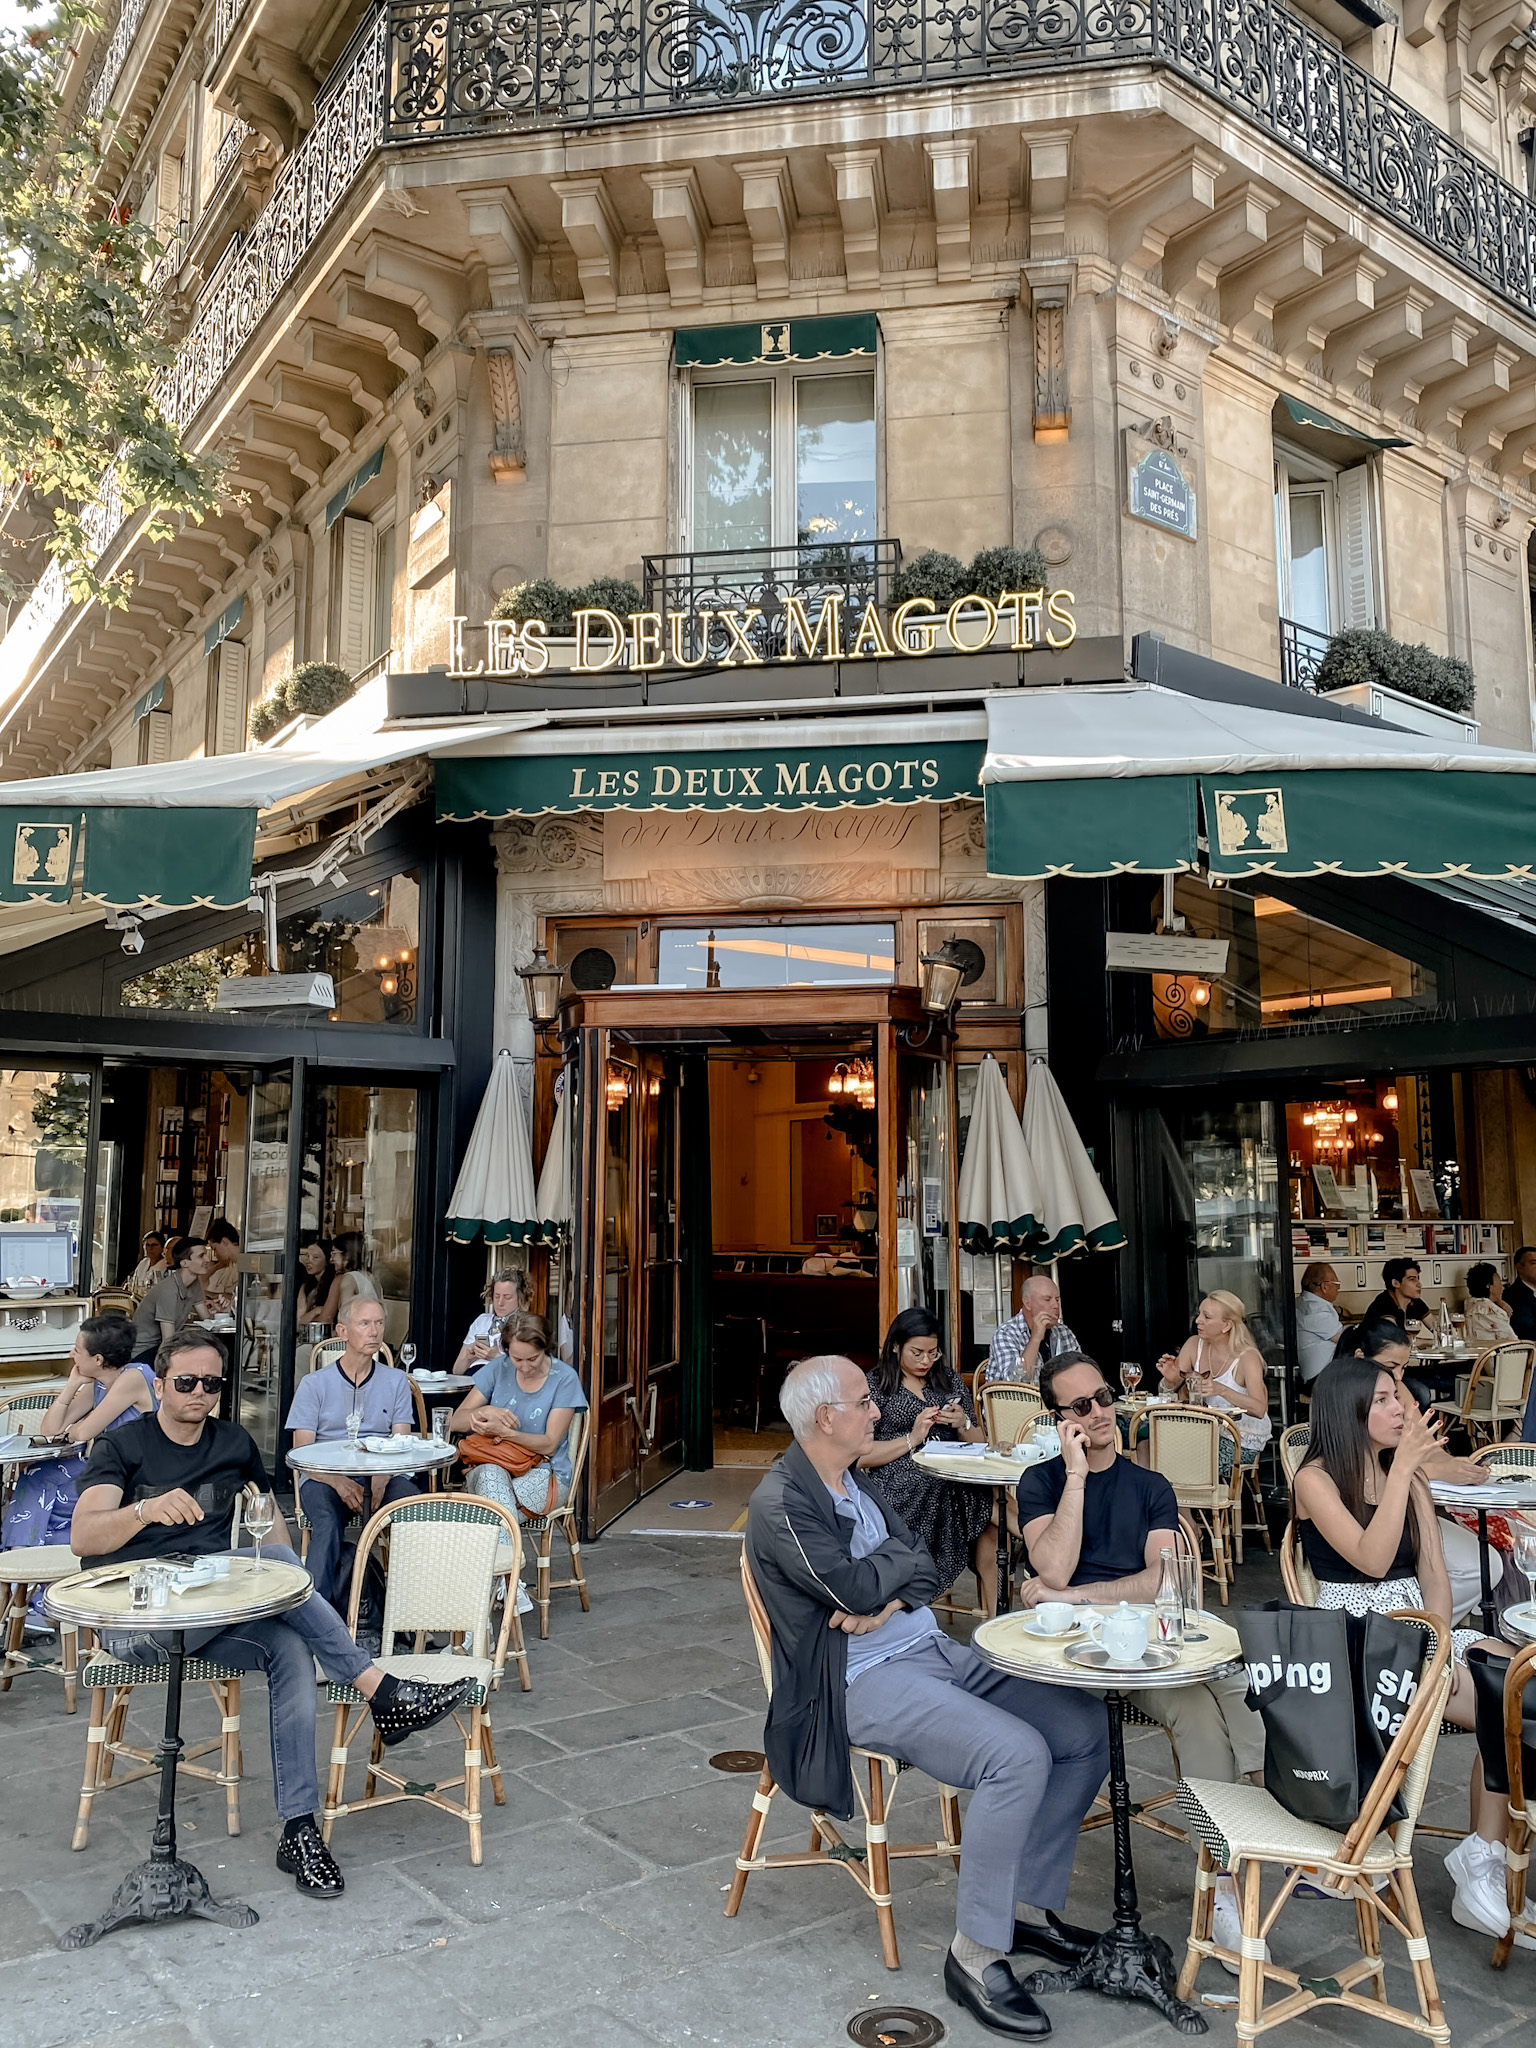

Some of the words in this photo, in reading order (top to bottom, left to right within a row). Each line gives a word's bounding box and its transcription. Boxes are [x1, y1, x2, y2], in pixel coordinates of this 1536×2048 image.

[1143, 486, 1186, 512] SAINT-GERMAIN
[1154, 478, 1174, 494] PLACE
[1150, 501, 1162, 515] DES
[445, 615, 549, 677] LES
[570, 608, 763, 671] DEUX
[779, 587, 1077, 661] MAGOTS
[569, 768, 639, 798] LES
[650, 765, 763, 797] DEUX
[774, 759, 940, 796] MAGOTS
[676, 811, 783, 847] Deux
[1244, 1654, 1332, 1695] ping
